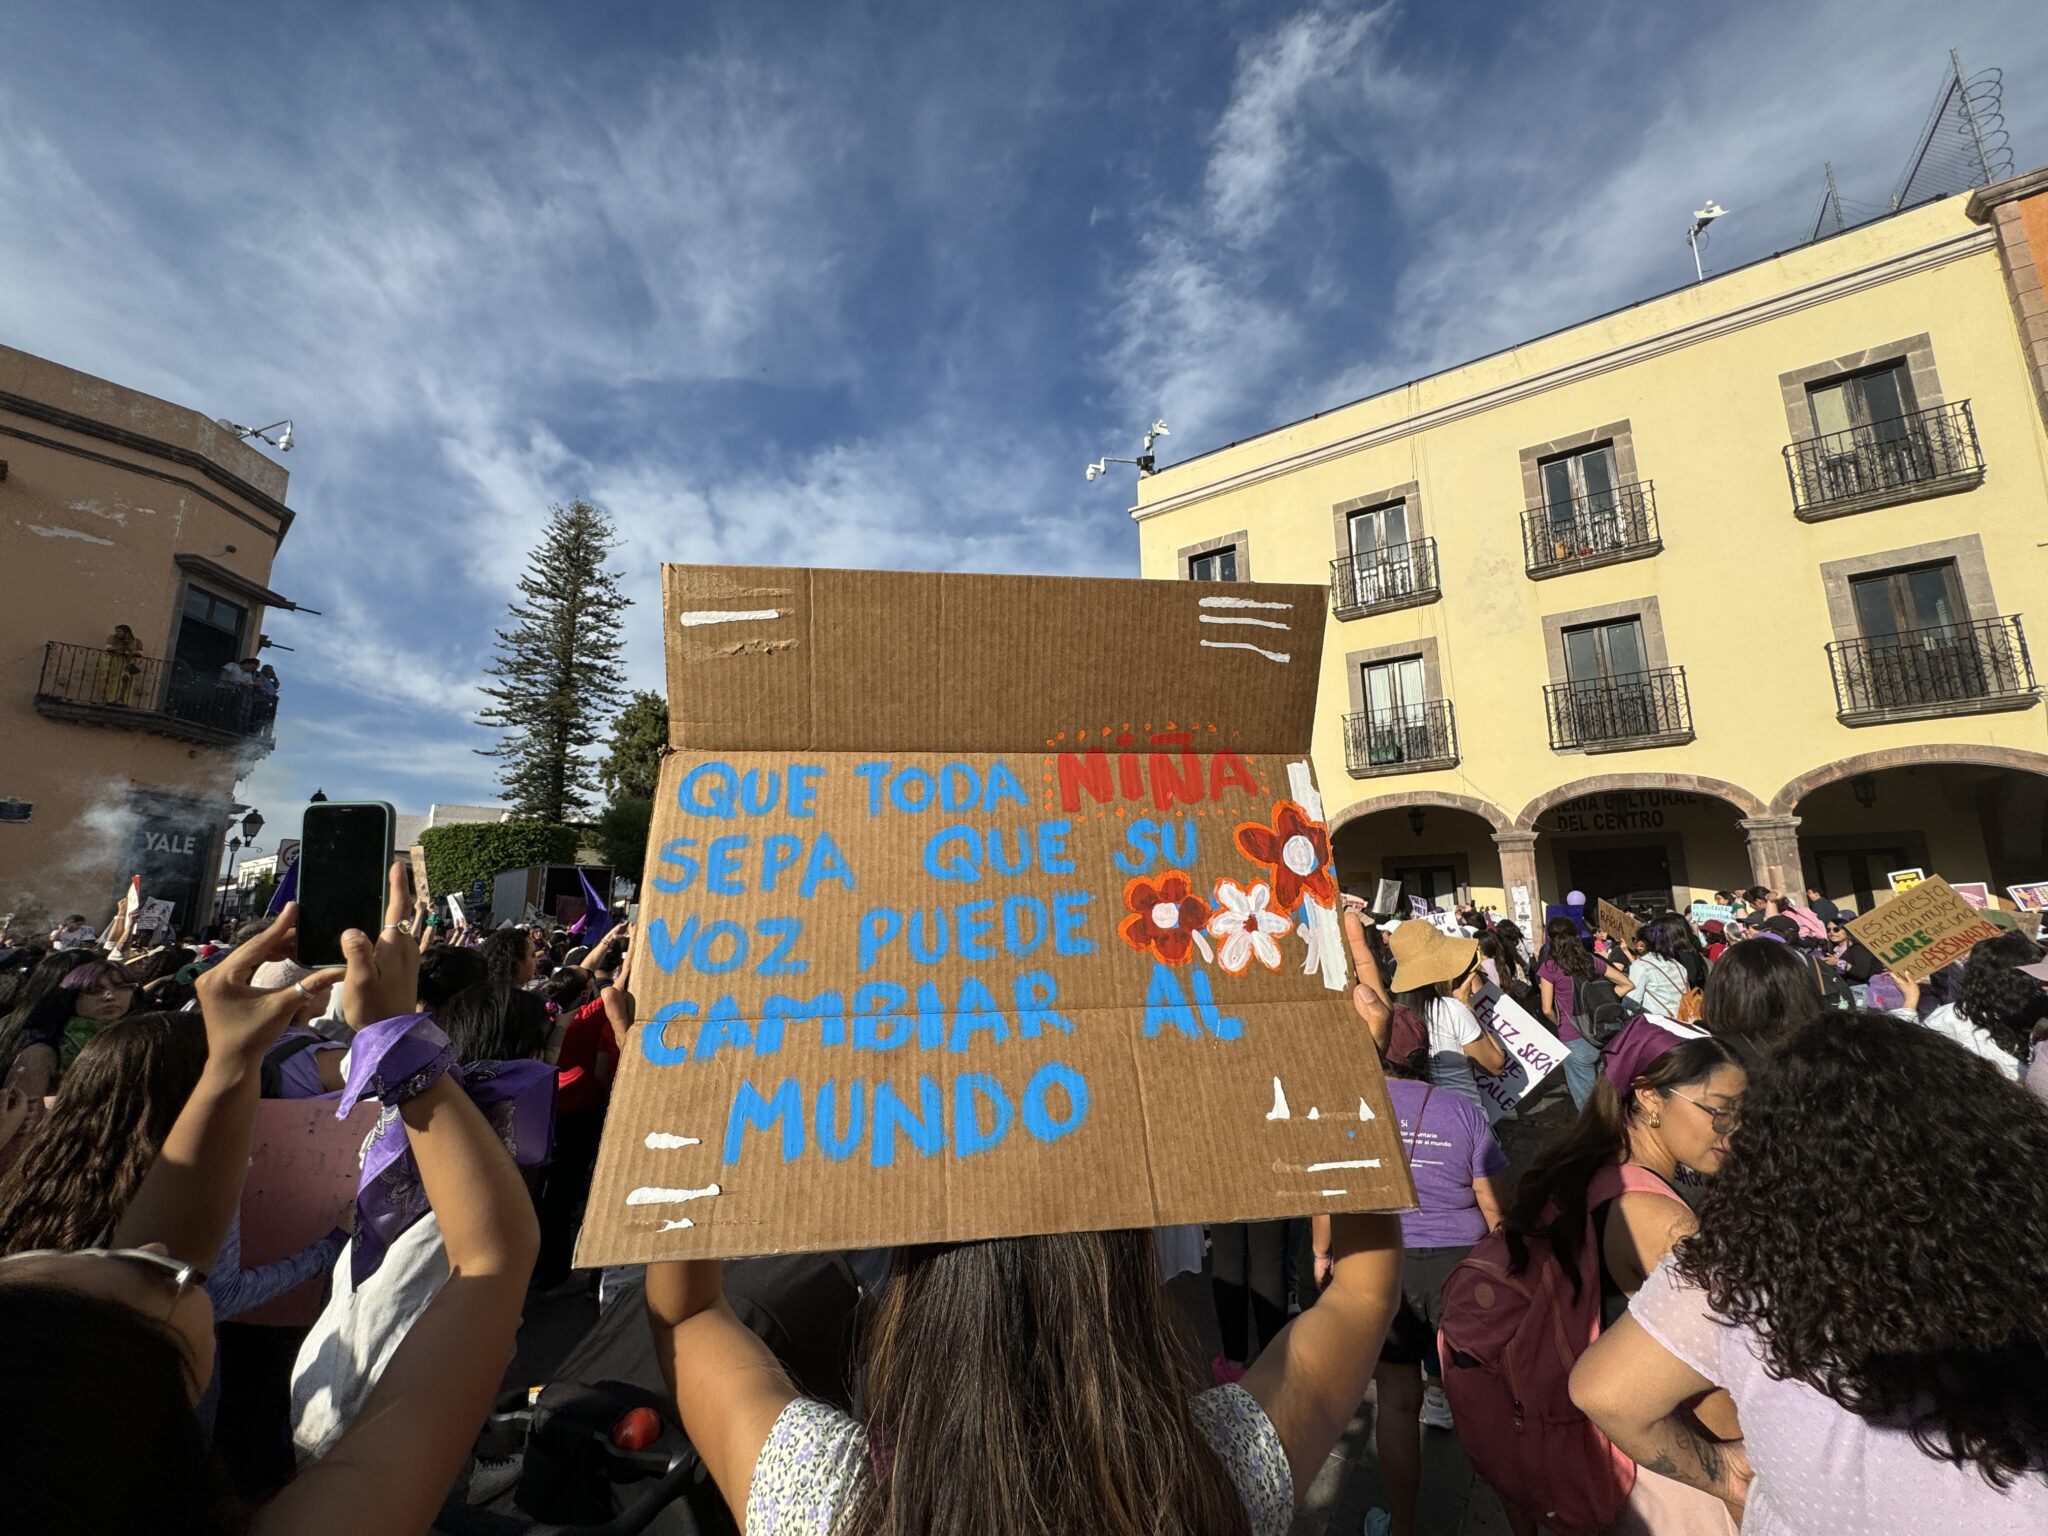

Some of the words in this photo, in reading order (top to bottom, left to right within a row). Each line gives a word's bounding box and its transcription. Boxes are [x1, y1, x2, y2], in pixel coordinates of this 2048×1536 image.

[677, 762, 827, 819] QUE
[854, 762, 1030, 814] TODA
[1056, 731, 1261, 812] NIÑA
[145, 831, 196, 855] YALE
[1557, 814, 1589, 832] DEL
[1593, 810, 1665, 830] CENTRO
[652, 832, 857, 898] SEPA
[924, 820, 1075, 882] QUE
[1113, 816, 1198, 875] SU
[1868, 929, 1898, 949] más
[1896, 916, 1923, 936] una
[1921, 896, 1957, 922] mujer
[1882, 884, 1949, 926] molesta
[647, 915, 810, 976] VOZ
[859, 890, 1100, 972] PUEDE
[1878, 930, 1934, 965] LIBRE
[1925, 920, 1949, 938] que
[1950, 907, 1978, 927] una
[1921, 920, 1999, 966] ASESINADA
[641, 971, 1076, 1066] CAMBIAR
[1142, 962, 1244, 1040] AL
[1474, 995, 1520, 1045] FELIZ
[723, 1062, 1090, 1167] MUNDO
[1475, 1075, 1516, 1111] CALLE
